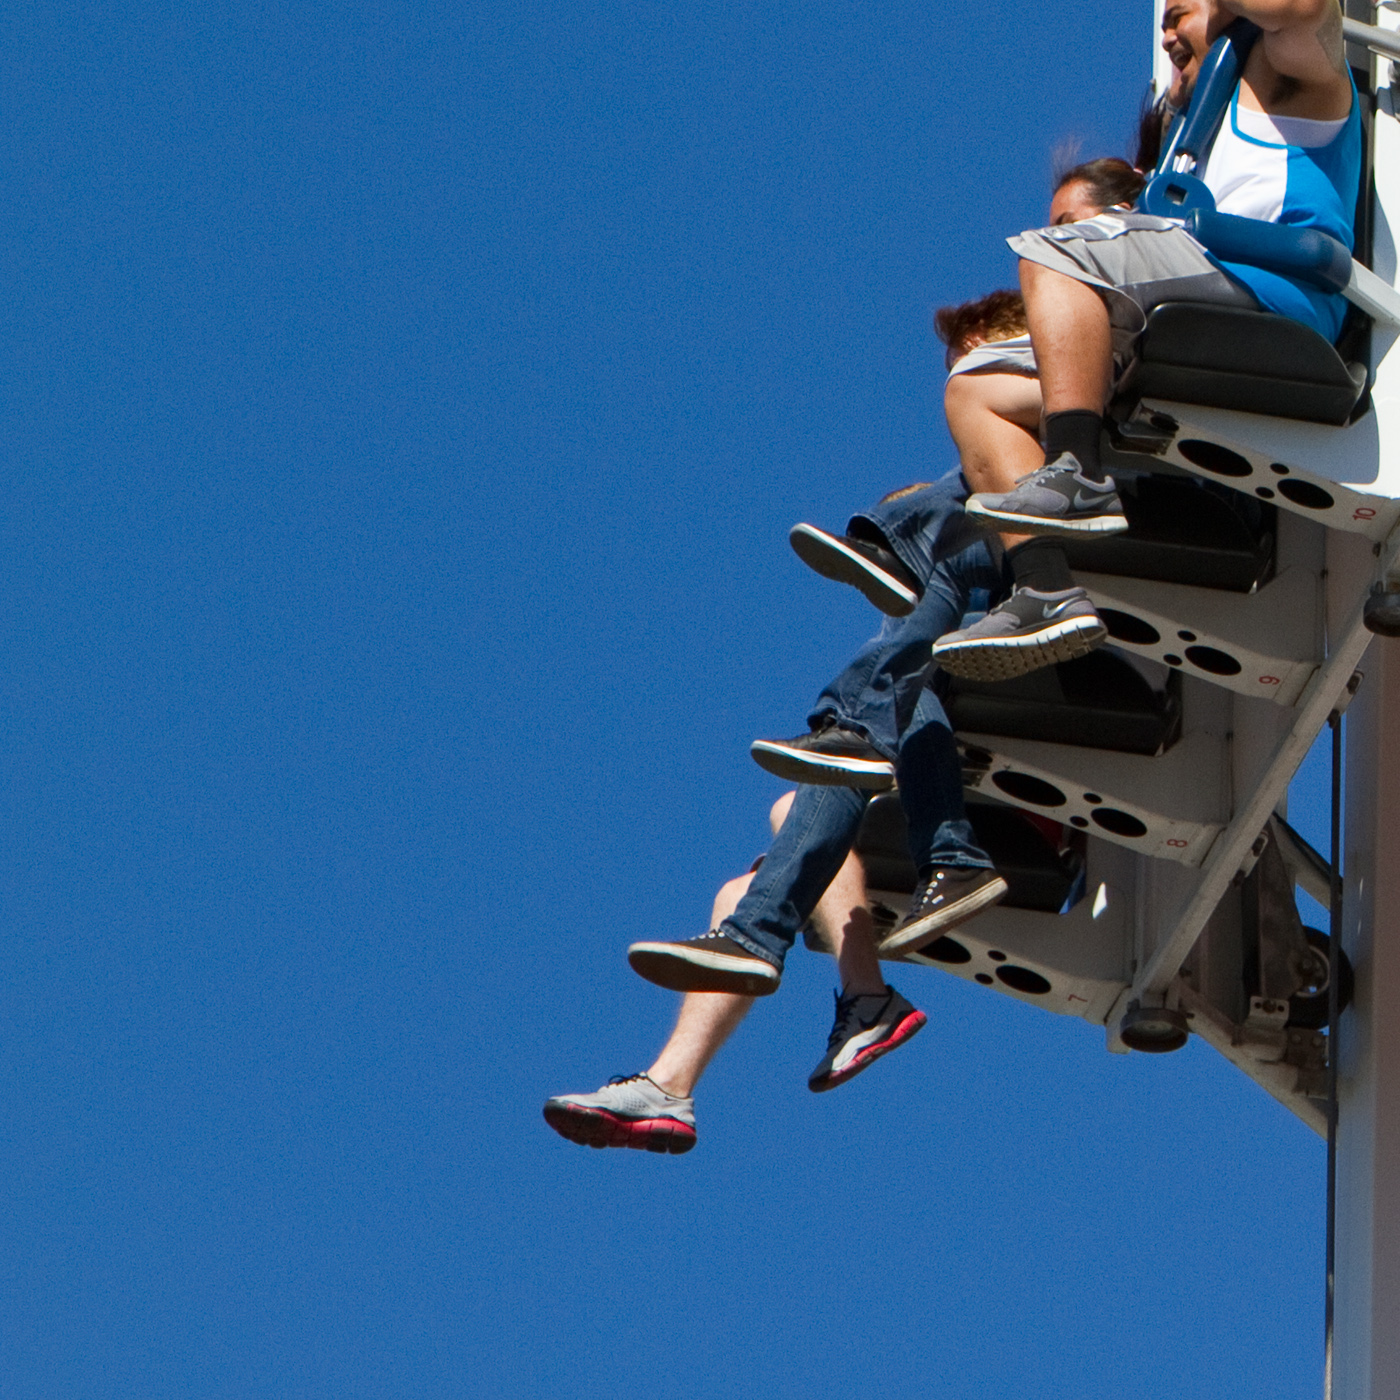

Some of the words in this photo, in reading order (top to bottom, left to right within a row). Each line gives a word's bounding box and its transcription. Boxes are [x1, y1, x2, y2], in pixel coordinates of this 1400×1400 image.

[1352, 507, 1376, 520] 10
[1259, 675, 1280, 685] 9
[1166, 838, 1188, 848] 8
[1068, 994, 1088, 1002] 7
